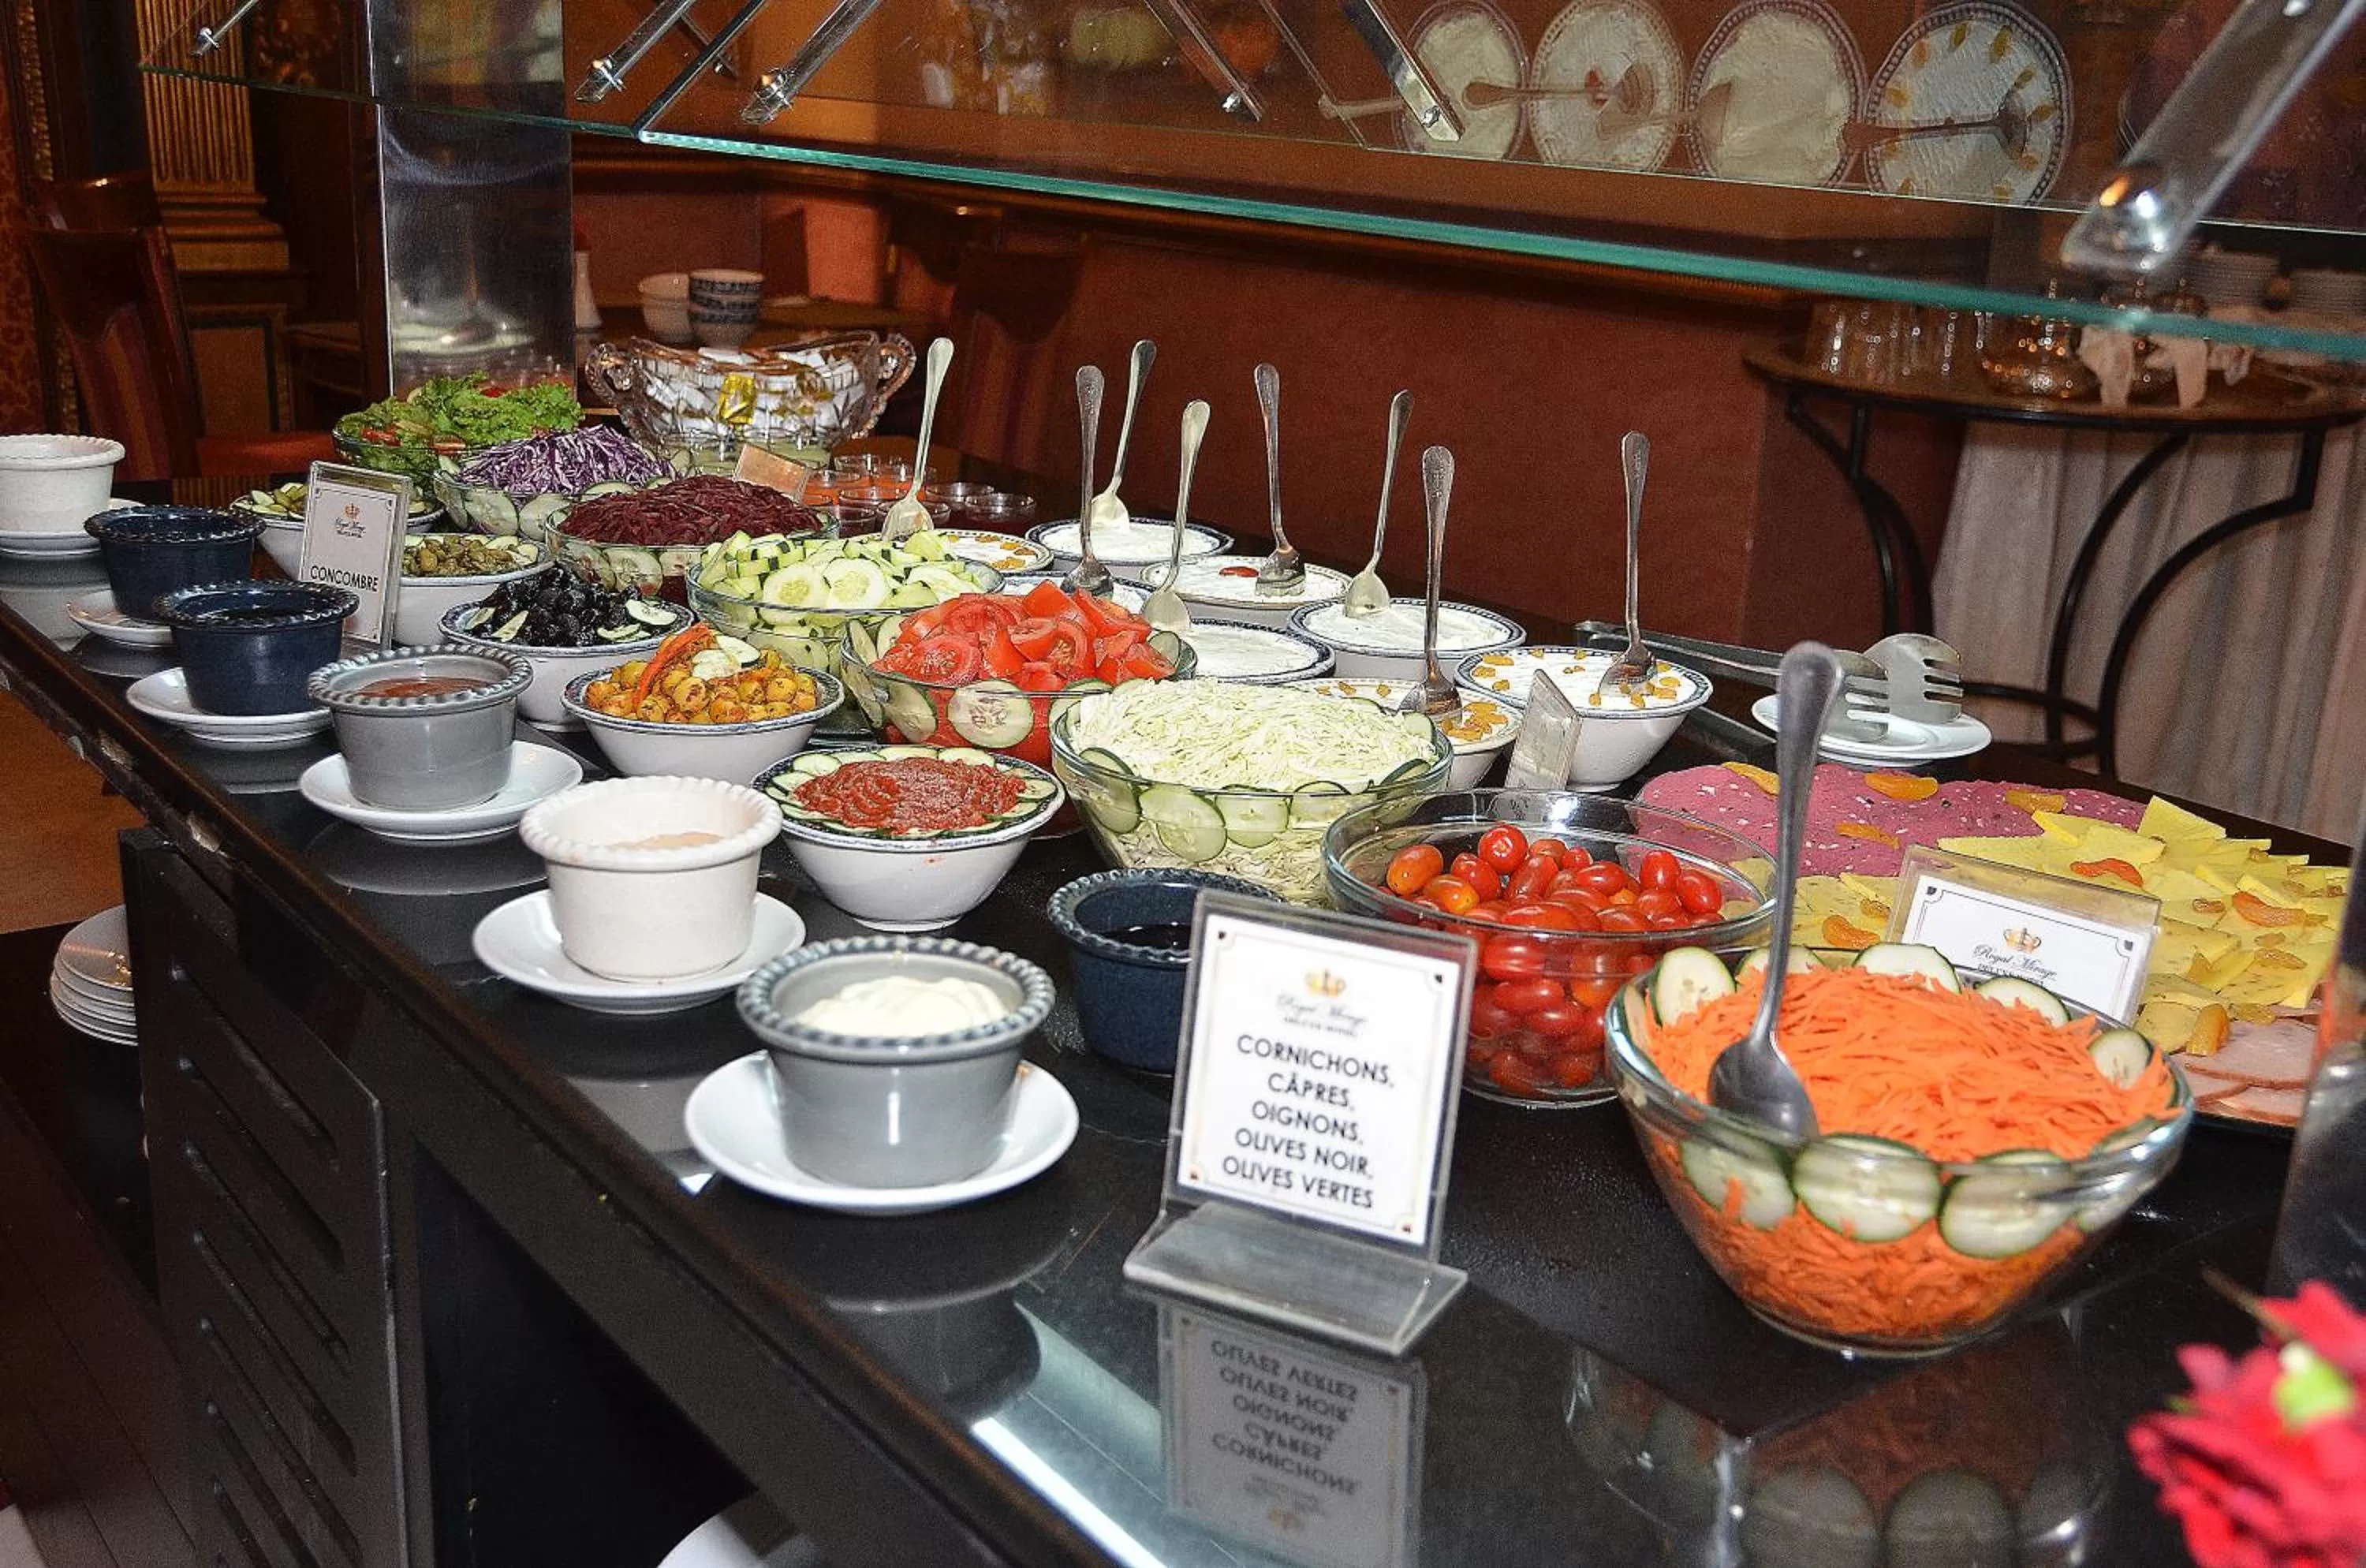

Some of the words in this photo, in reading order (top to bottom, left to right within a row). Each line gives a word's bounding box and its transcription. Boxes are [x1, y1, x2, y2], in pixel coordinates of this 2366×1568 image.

[311, 565, 379, 591] CONCOMBRE
[1235, 1128, 1306, 1160] OLIVES
[1222, 1155, 1293, 1189] OLIVES
[1302, 1175, 1373, 1208] VERTES
